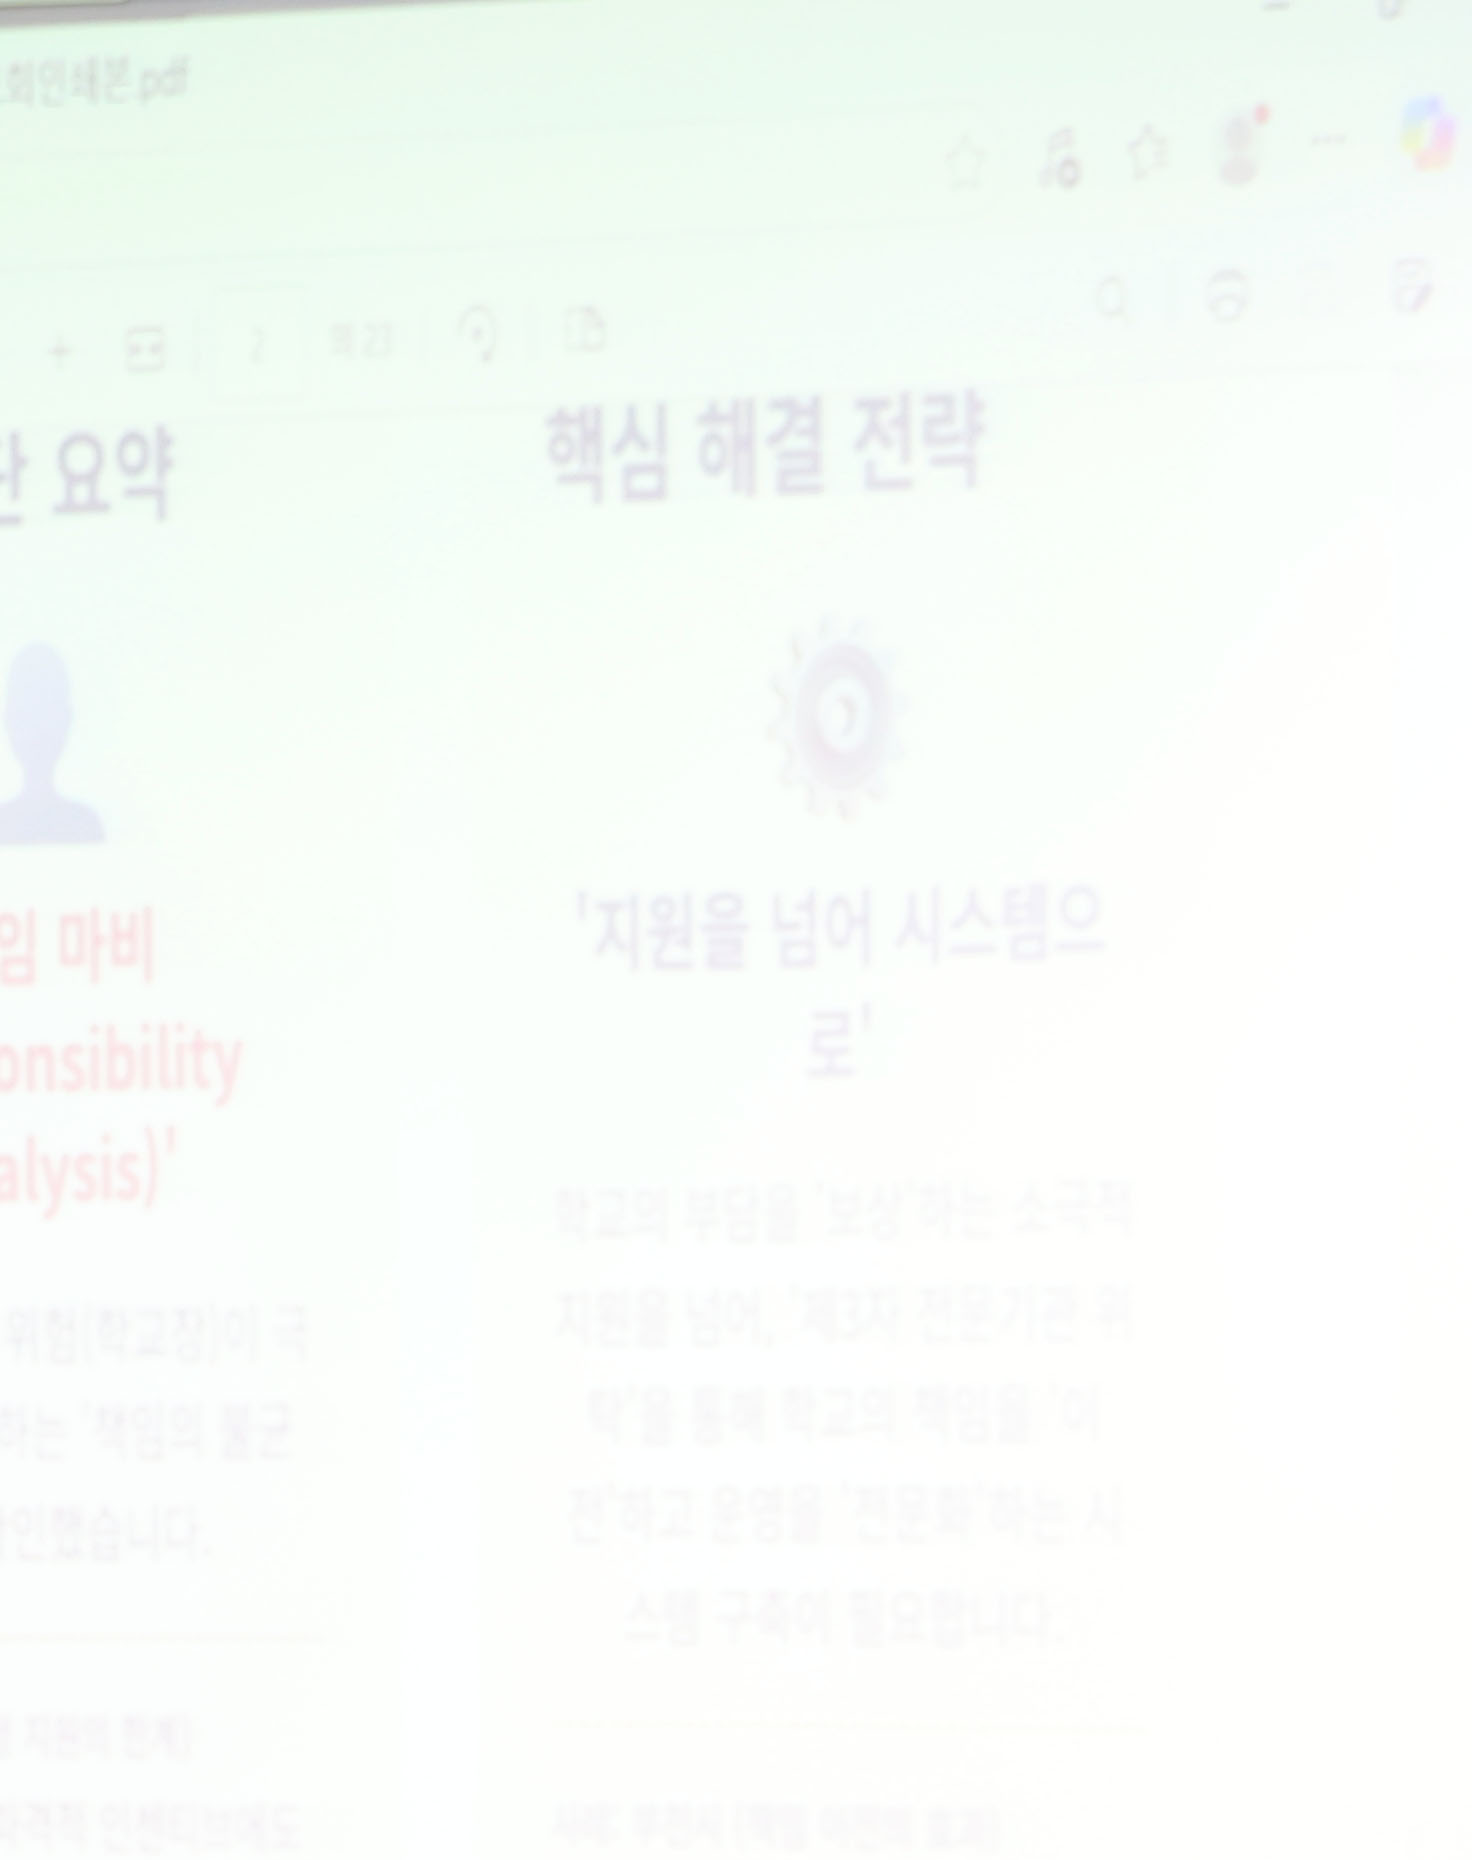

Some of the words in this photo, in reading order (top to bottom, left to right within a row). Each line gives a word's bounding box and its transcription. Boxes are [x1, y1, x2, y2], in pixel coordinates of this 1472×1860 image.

[50, 421, 177, 525] 요약
[544, 398, 673, 507] 핵심
[696, 393, 828, 500] 해결
[851, 387, 989, 492] 전략
[57, 903, 157, 985] 마비
[576, 886, 750, 974] '지원을
[771, 886, 873, 971] 넘어
[894, 882, 1108, 967] 시스템으
[806, 1001, 874, 1080] 로'
[80, 1397, 207, 1461] '책임의
[218, 1399, 297, 1463] 불균
